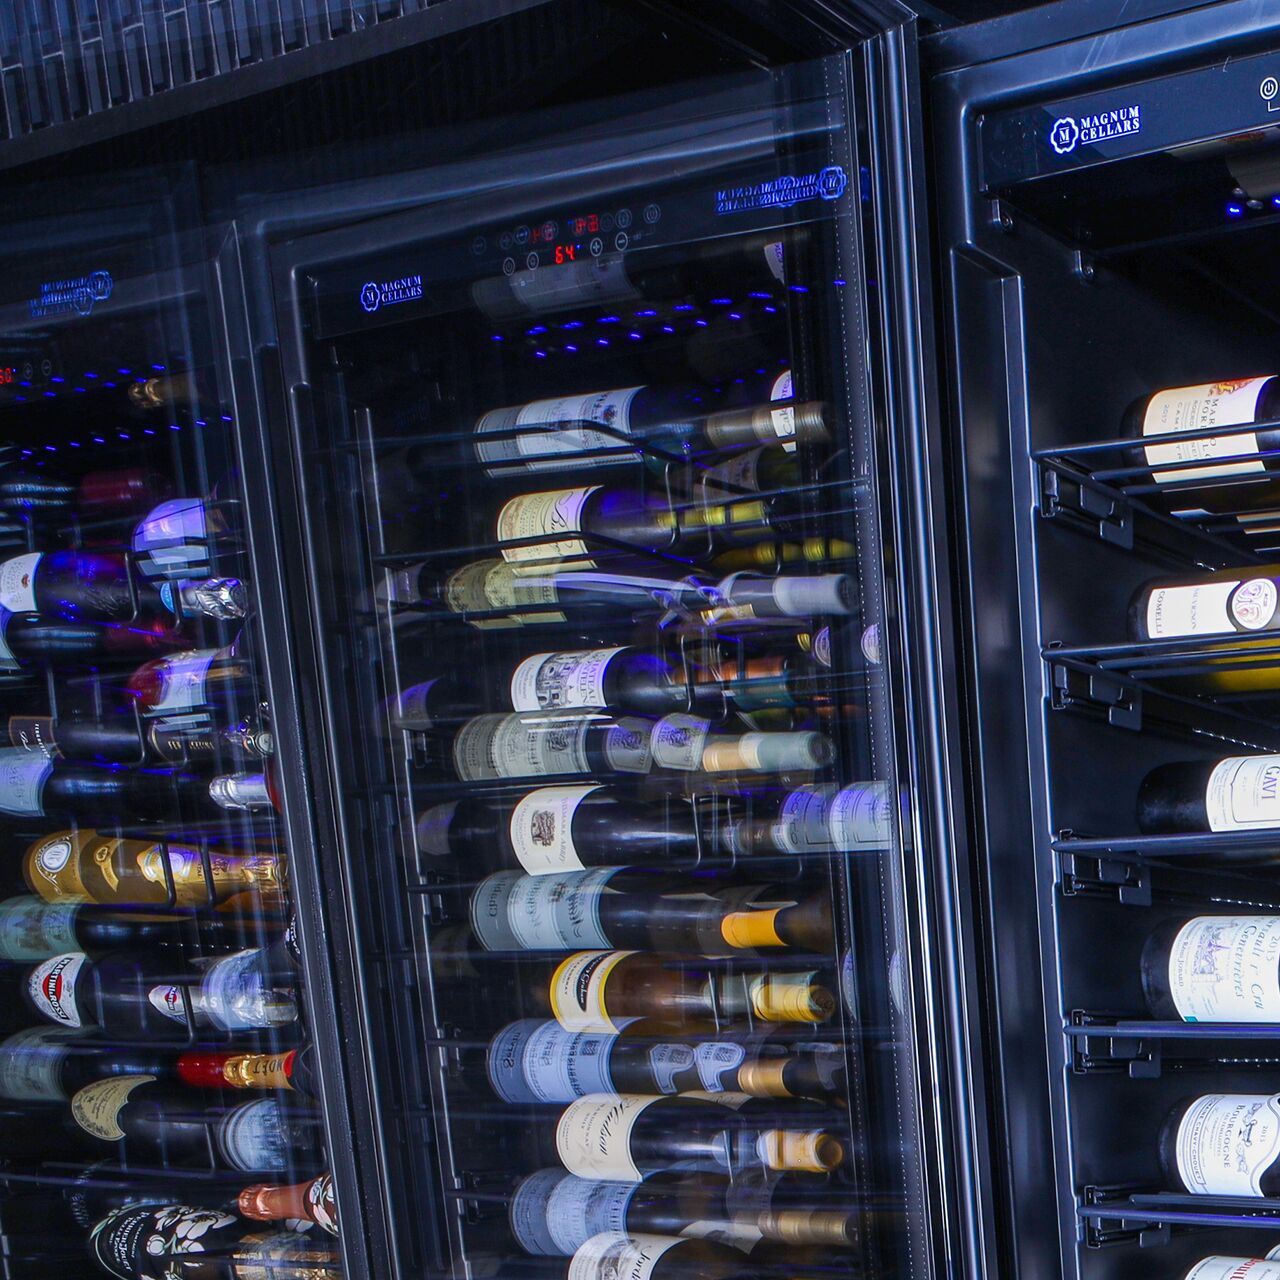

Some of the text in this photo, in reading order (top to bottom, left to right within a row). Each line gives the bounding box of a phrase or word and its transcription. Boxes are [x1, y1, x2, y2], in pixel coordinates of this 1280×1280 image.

[1080, 105, 1140, 130] MAGNUM
[1080, 117, 1140, 142] CELLARS
[555, 245, 576, 265] 64
[381, 275, 422, 292] MAGNUM
[381, 285, 423, 304] CELLARS
[1155, 590, 1167, 636] COMELLI
[47, 957, 76, 1021] MARTINI ROSSI
[1222, 1104, 1247, 1169] BOURGOGNE
